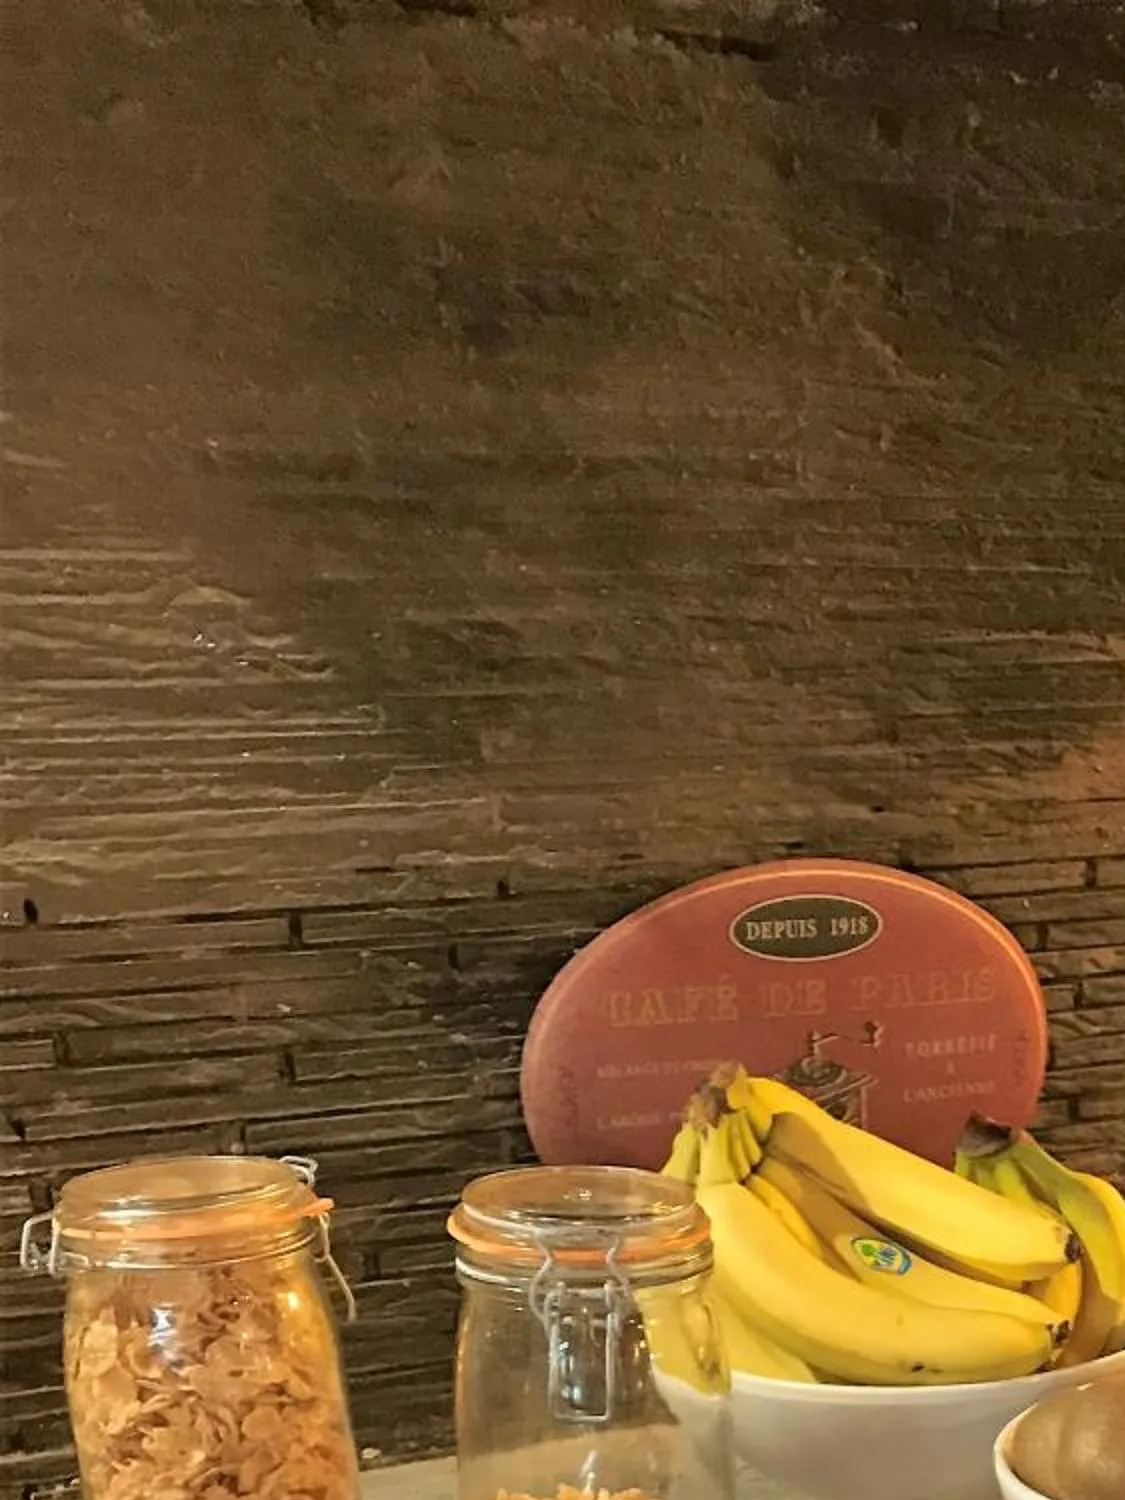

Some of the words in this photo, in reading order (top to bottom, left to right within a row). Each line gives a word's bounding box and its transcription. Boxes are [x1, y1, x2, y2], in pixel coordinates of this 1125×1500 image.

[745, 919, 819, 942] DEPUIS
[829, 914, 871, 938] 1918
[758, 977, 828, 1018] DE
